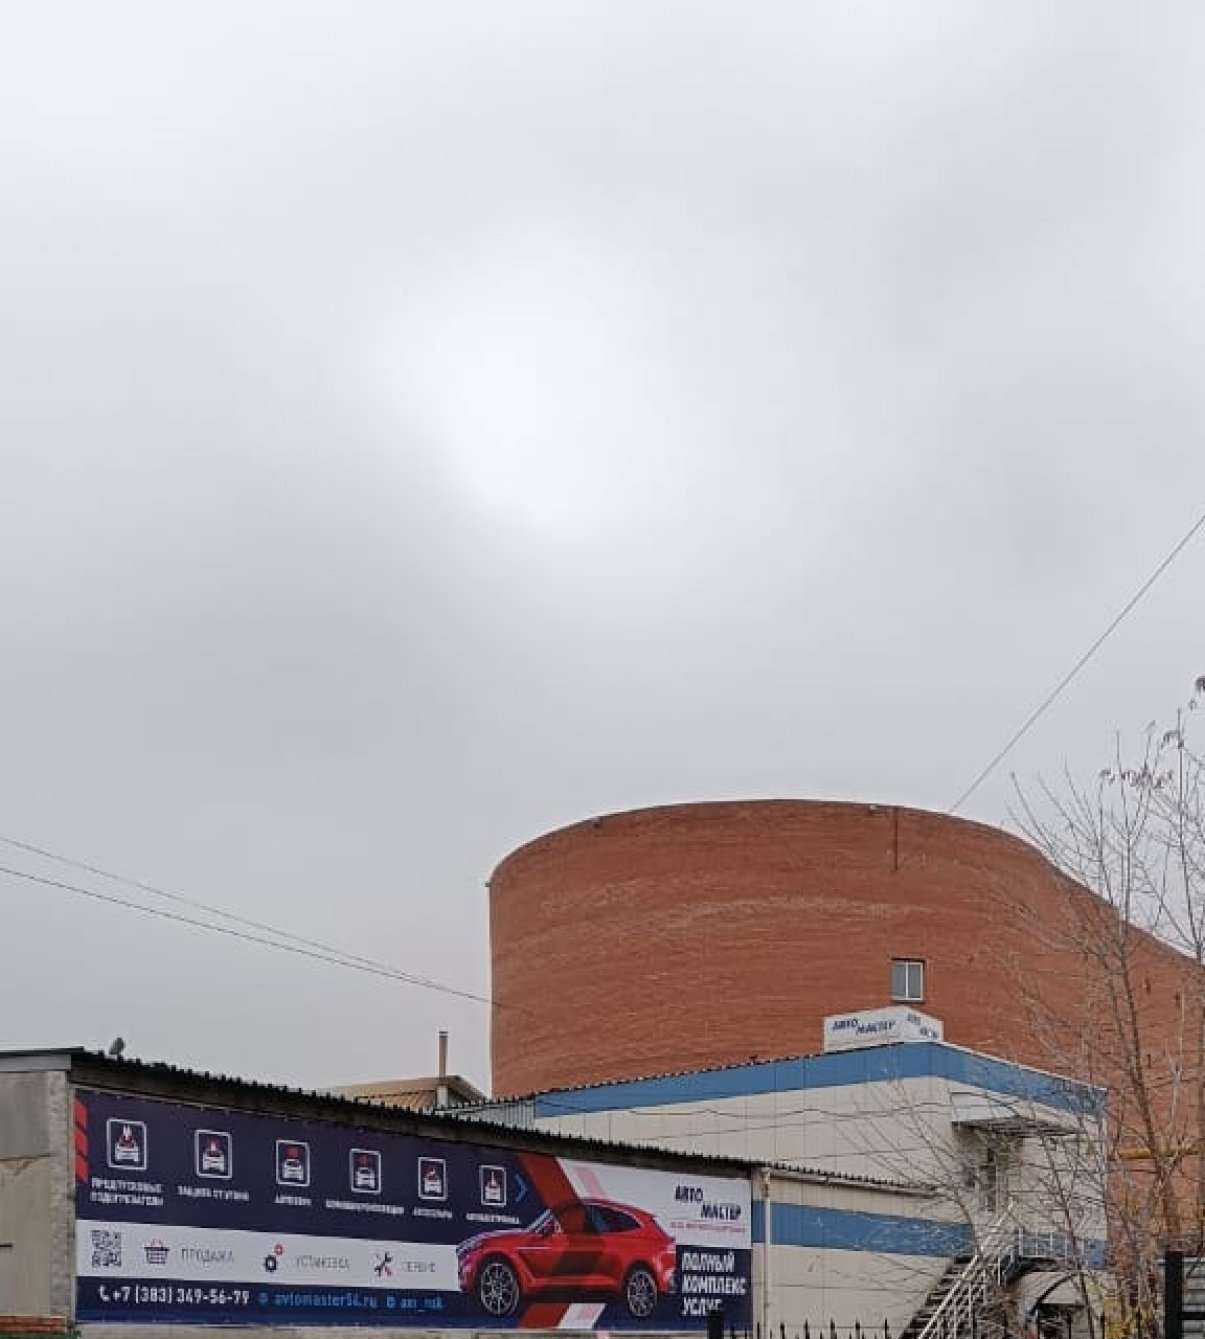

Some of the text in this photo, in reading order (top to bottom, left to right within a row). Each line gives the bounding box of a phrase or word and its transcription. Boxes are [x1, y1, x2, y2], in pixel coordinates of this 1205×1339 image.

[675, 1185, 704, 1203] АВТО
[701, 1204, 742, 1220] МАСТЕР
[181, 1248, 234, 1264] ПРОДАЖА
[682, 1250, 735, 1273] ПОЛНЫЙ
[682, 1273, 746, 1295] КОМПЛЕКС
[136, 1284, 172, 1303] (383)
[177, 1288, 250, 1304] 349-56-79
